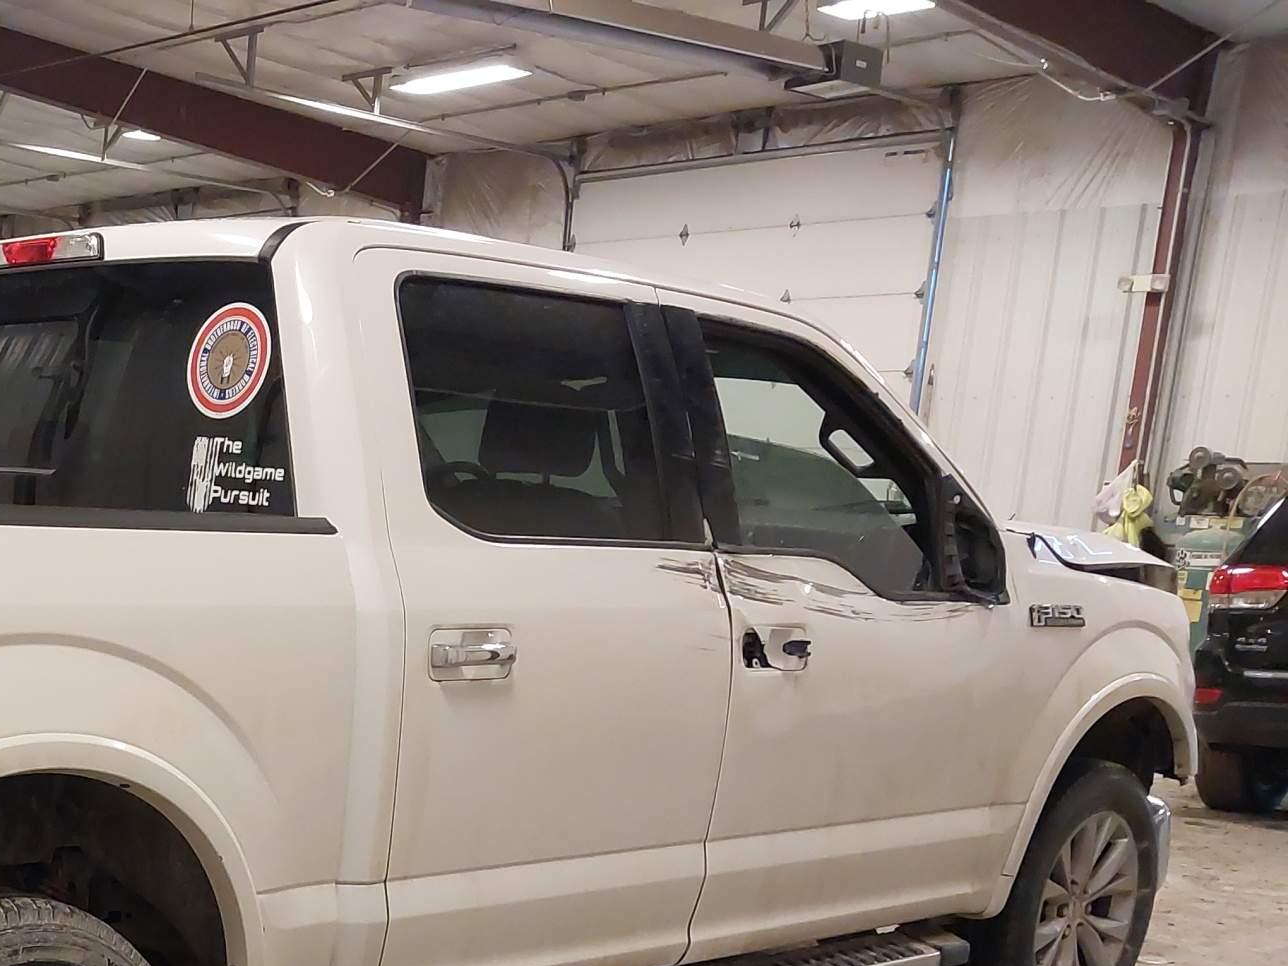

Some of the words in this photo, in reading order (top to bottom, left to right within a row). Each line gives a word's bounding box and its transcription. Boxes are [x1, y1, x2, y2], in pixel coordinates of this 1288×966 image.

[205, 319, 241, 351] BROTHERHOOD
[247, 330, 258, 372] ELECTRICAL
[213, 437, 243, 454] The
[214, 462, 285, 484] Wildgame
[209, 485, 271, 506] Pursuit
